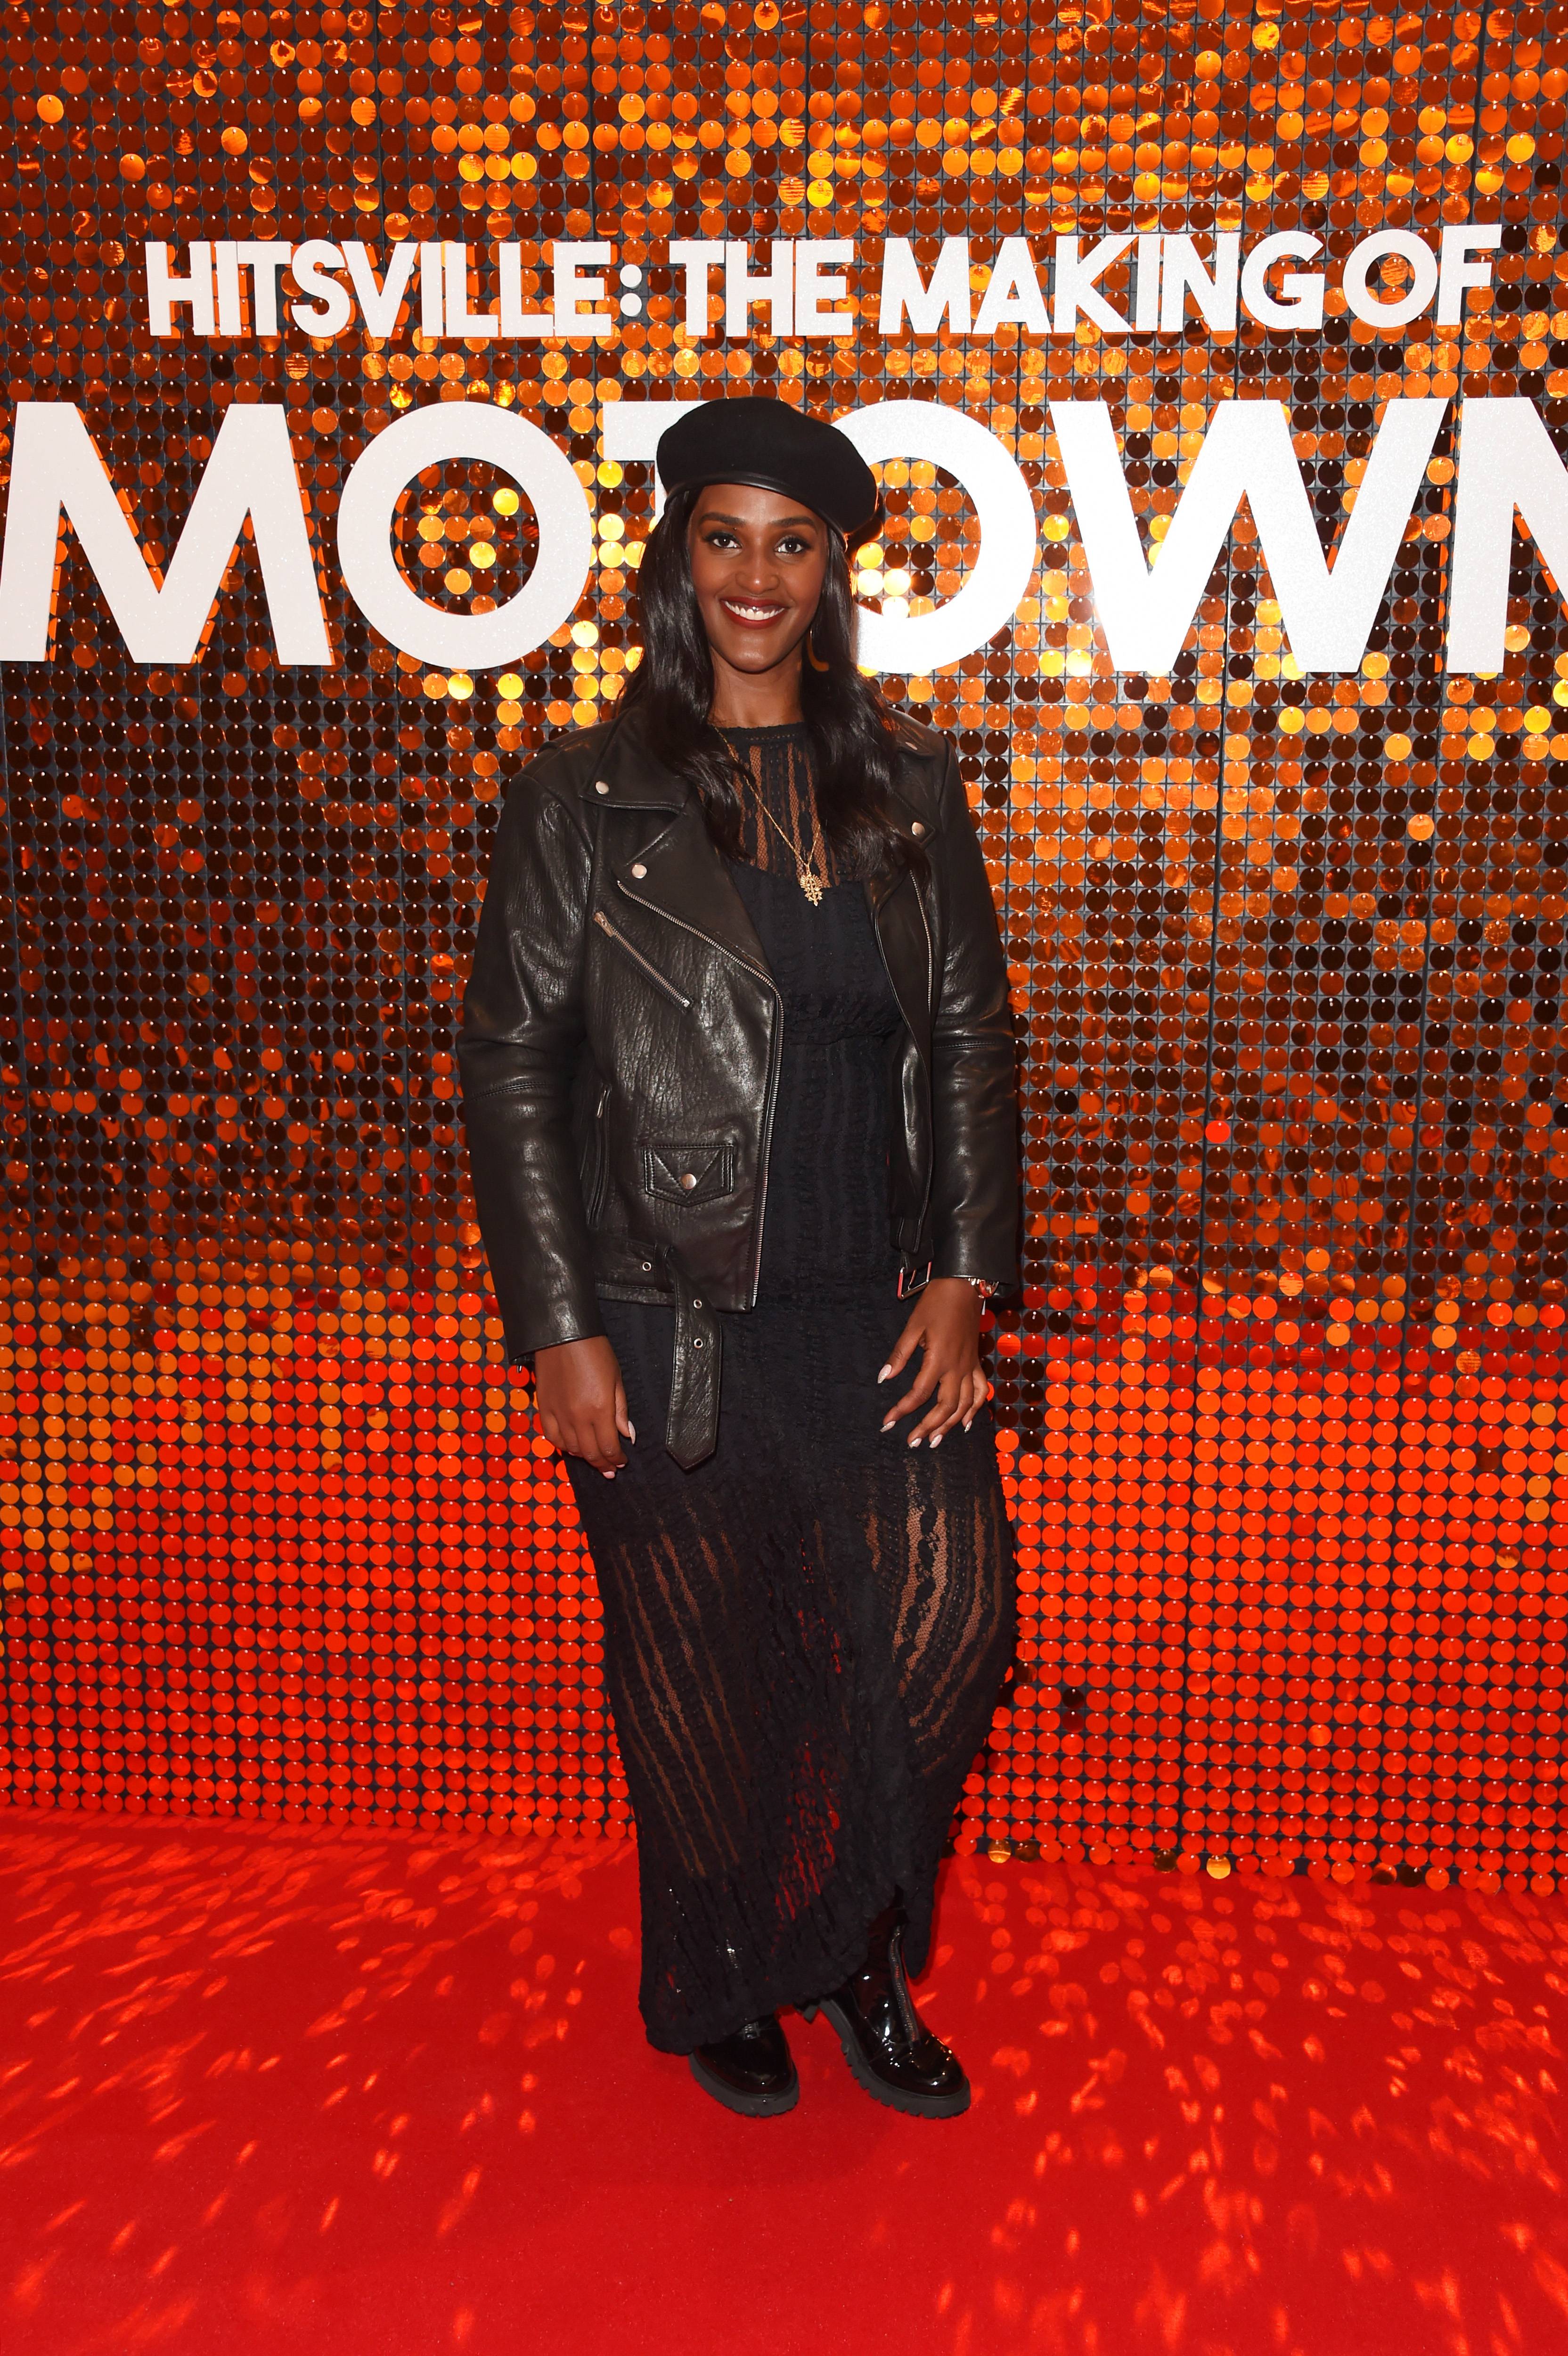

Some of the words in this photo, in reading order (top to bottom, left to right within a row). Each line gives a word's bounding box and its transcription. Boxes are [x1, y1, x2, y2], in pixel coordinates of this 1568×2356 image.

[145, 240, 643, 338] HITSVILLE:
[669, 237, 854, 336] THE
[878, 230, 1326, 335] MAKING
[1342, 224, 1503, 328] OF
[0, 396, 1568, 679] MOOWN
